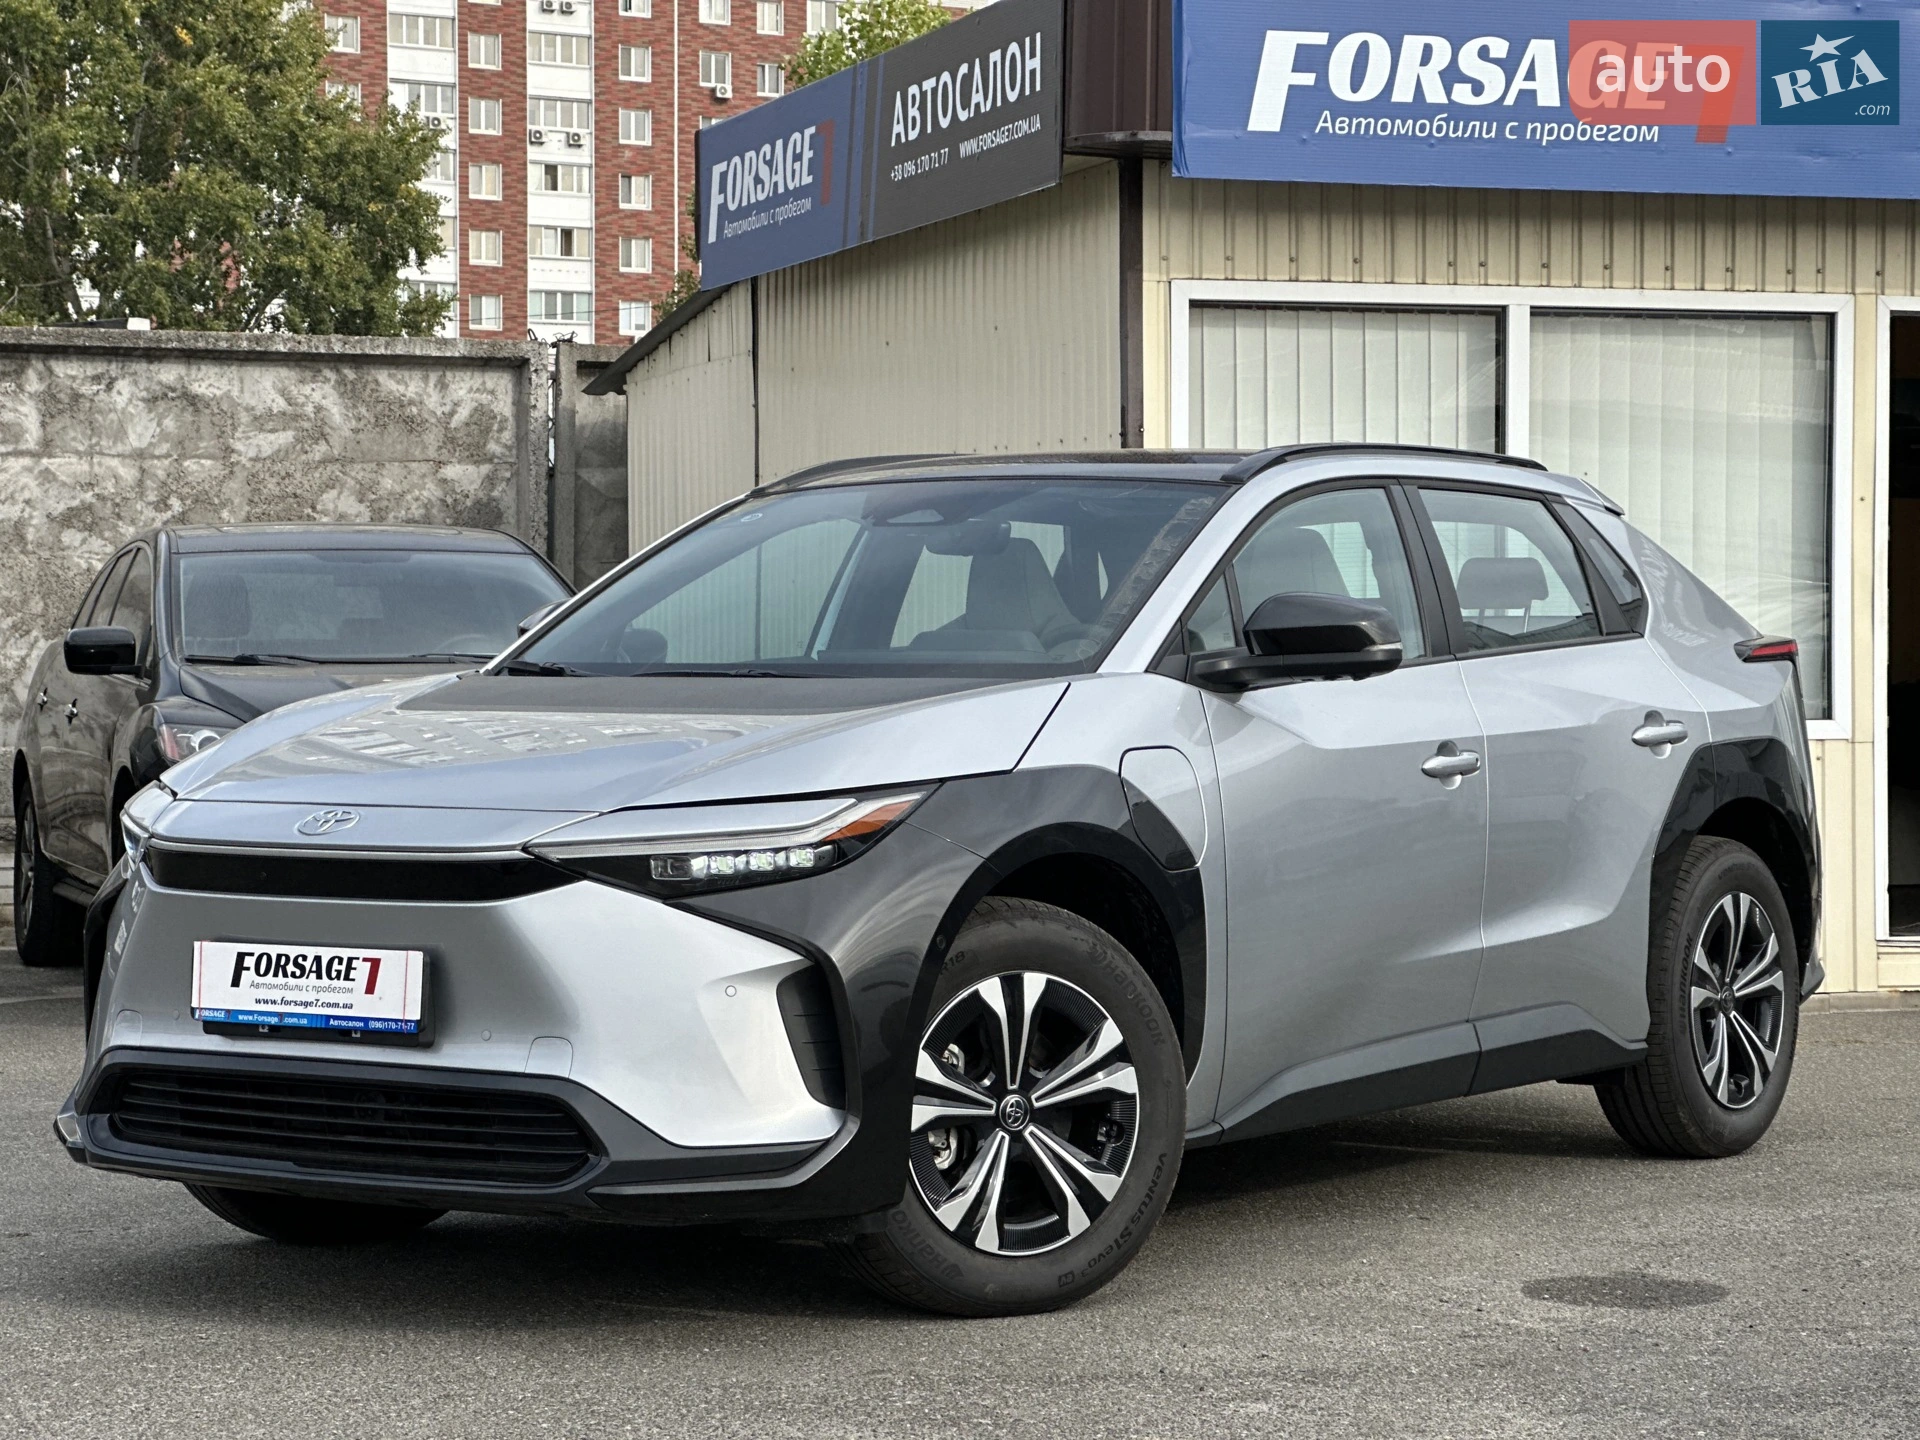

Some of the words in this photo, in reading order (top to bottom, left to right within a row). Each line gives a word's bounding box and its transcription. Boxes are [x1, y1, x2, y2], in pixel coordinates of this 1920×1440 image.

[890, 31, 1041, 147] АВТОСАЛОН
[1315, 109, 1497, 139] Автомобили
[1526, 117, 1660, 146] пробегом
[891, 164, 903, 181] +38
[904, 159, 916, 178] 096
[917, 154, 930, 172] 170
[930, 150, 939, 169] 71
[940, 147, 949, 166] 77
[959, 113, 1041, 158] WWW.FORSAGE7.COM.UA
[723, 209, 769, 239] Автомобили
[774, 196, 812, 226] пробегом
[249, 980, 304, 992] Автомобили
[311, 983, 354, 995] пробегом
[254, 996, 354, 1010] www.forsage7.com.ua
[329, 1018, 364, 1028] Автосалон
